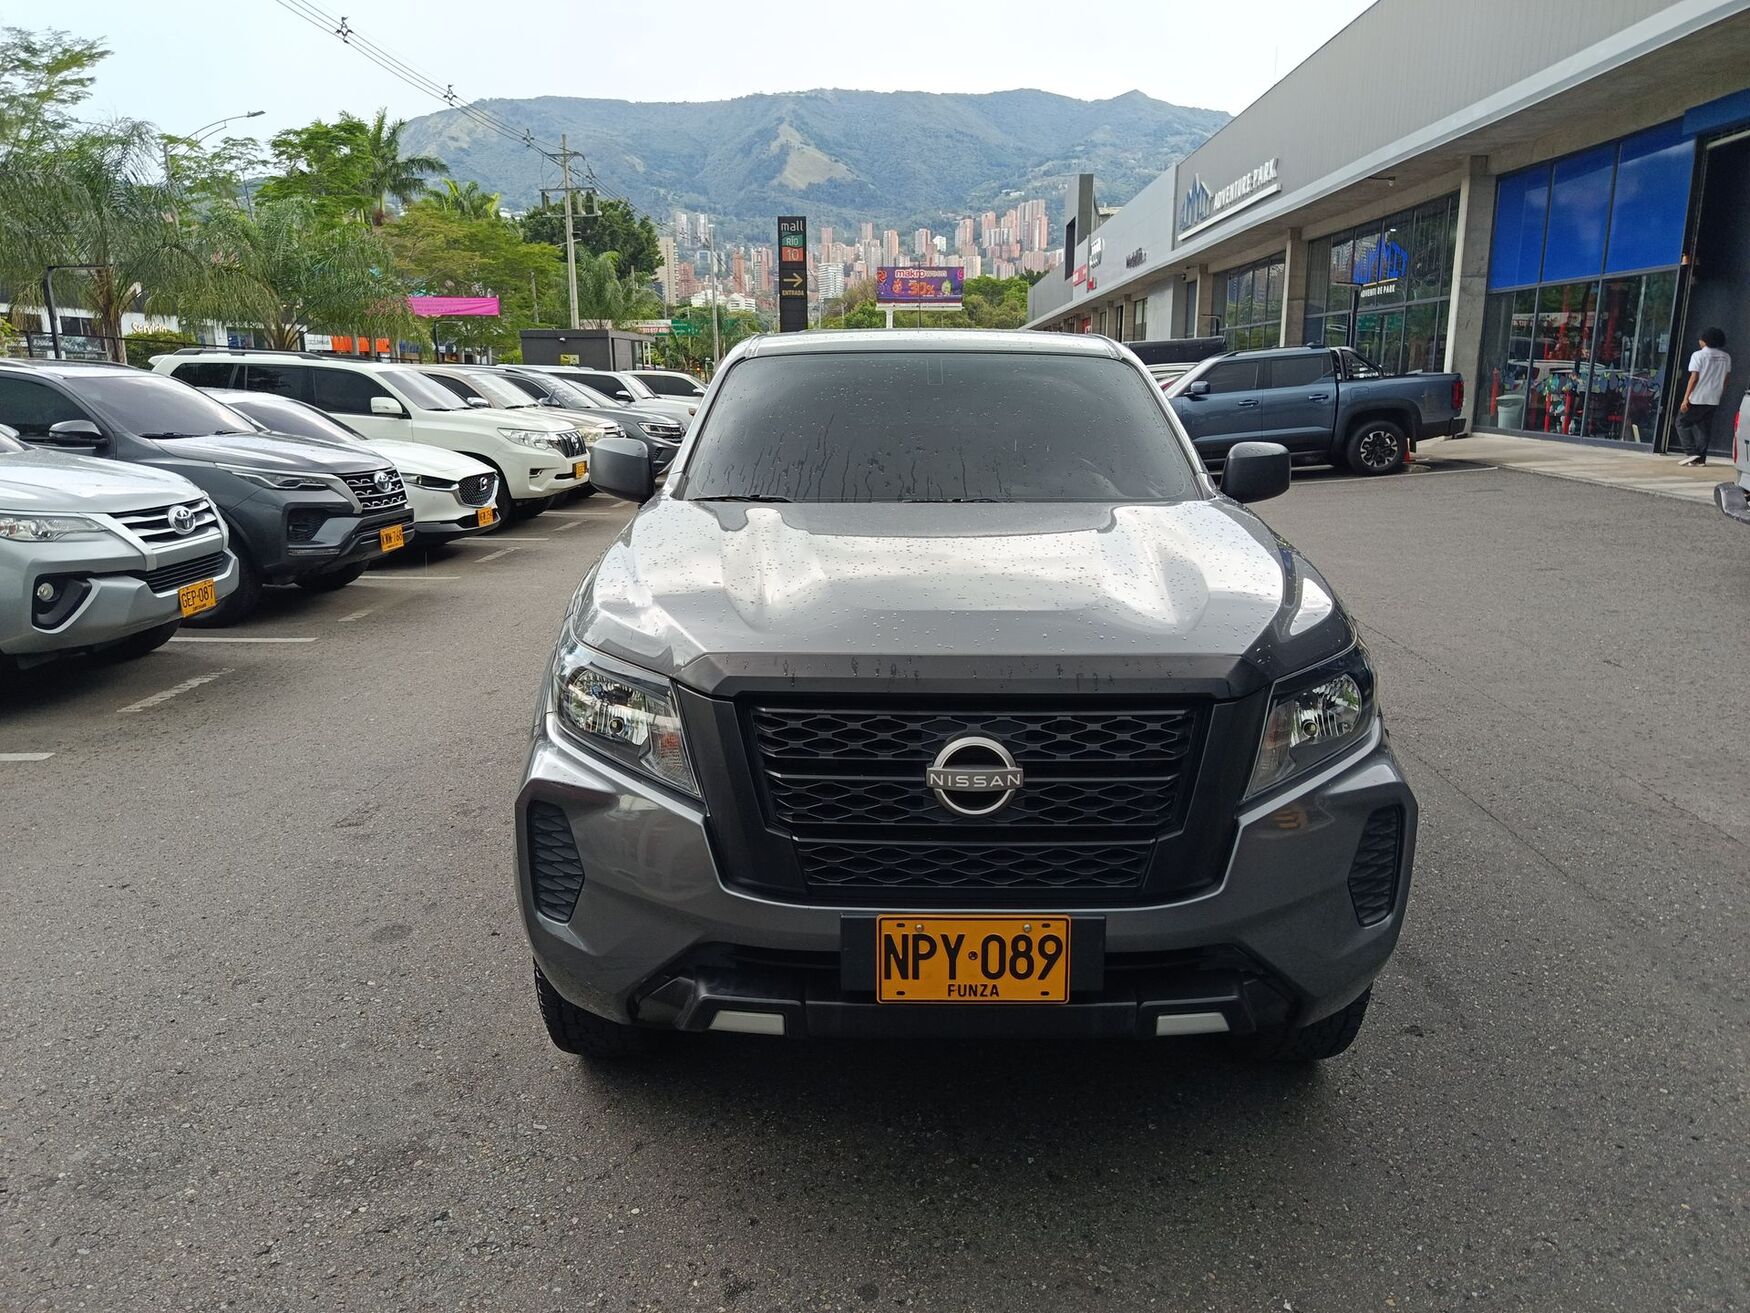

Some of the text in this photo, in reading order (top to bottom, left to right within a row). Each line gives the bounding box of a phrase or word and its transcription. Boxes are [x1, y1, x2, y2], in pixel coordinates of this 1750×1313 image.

[1213, 158, 1278, 211] ADVENTURE PARK
[781, 220, 804, 232] mall
[787, 249, 799, 261] 10
[1383, 284, 1396, 294] PARK
[930, 773, 1020, 788] NISSAN
[947, 983, 999, 998] FUNZA
